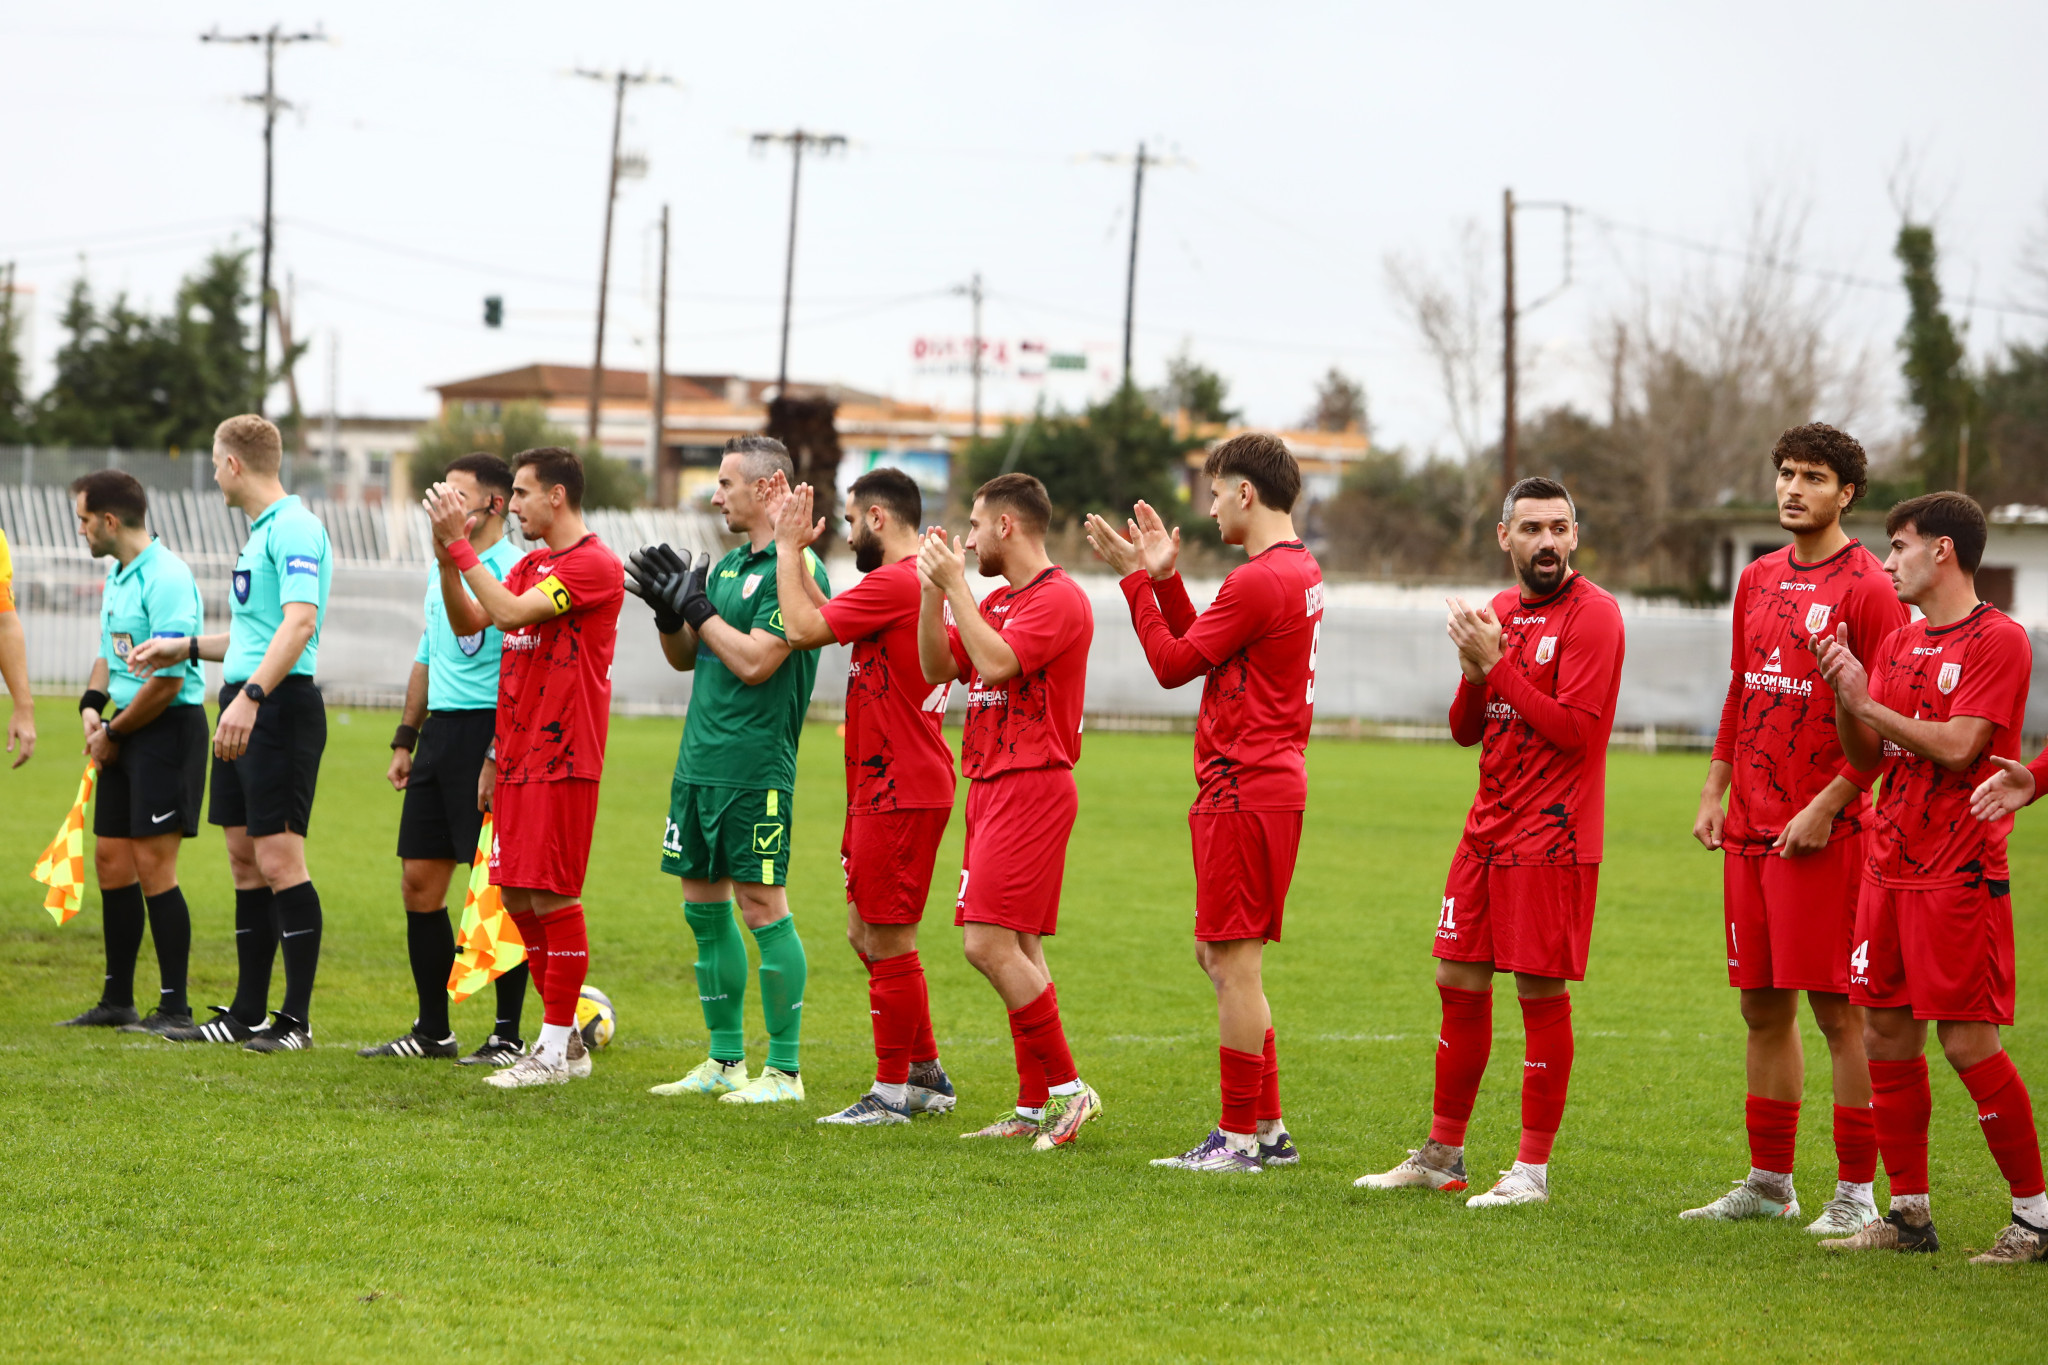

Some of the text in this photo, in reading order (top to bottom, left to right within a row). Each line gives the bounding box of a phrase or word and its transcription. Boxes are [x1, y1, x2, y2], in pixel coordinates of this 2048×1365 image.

[1780, 581, 1816, 592] GIVOVA
[553, 588, 570, 609] C
[1744, 671, 1778, 686] RICOM
[662, 849, 681, 859] OVA
[1524, 1060, 1547, 1069] OVA
